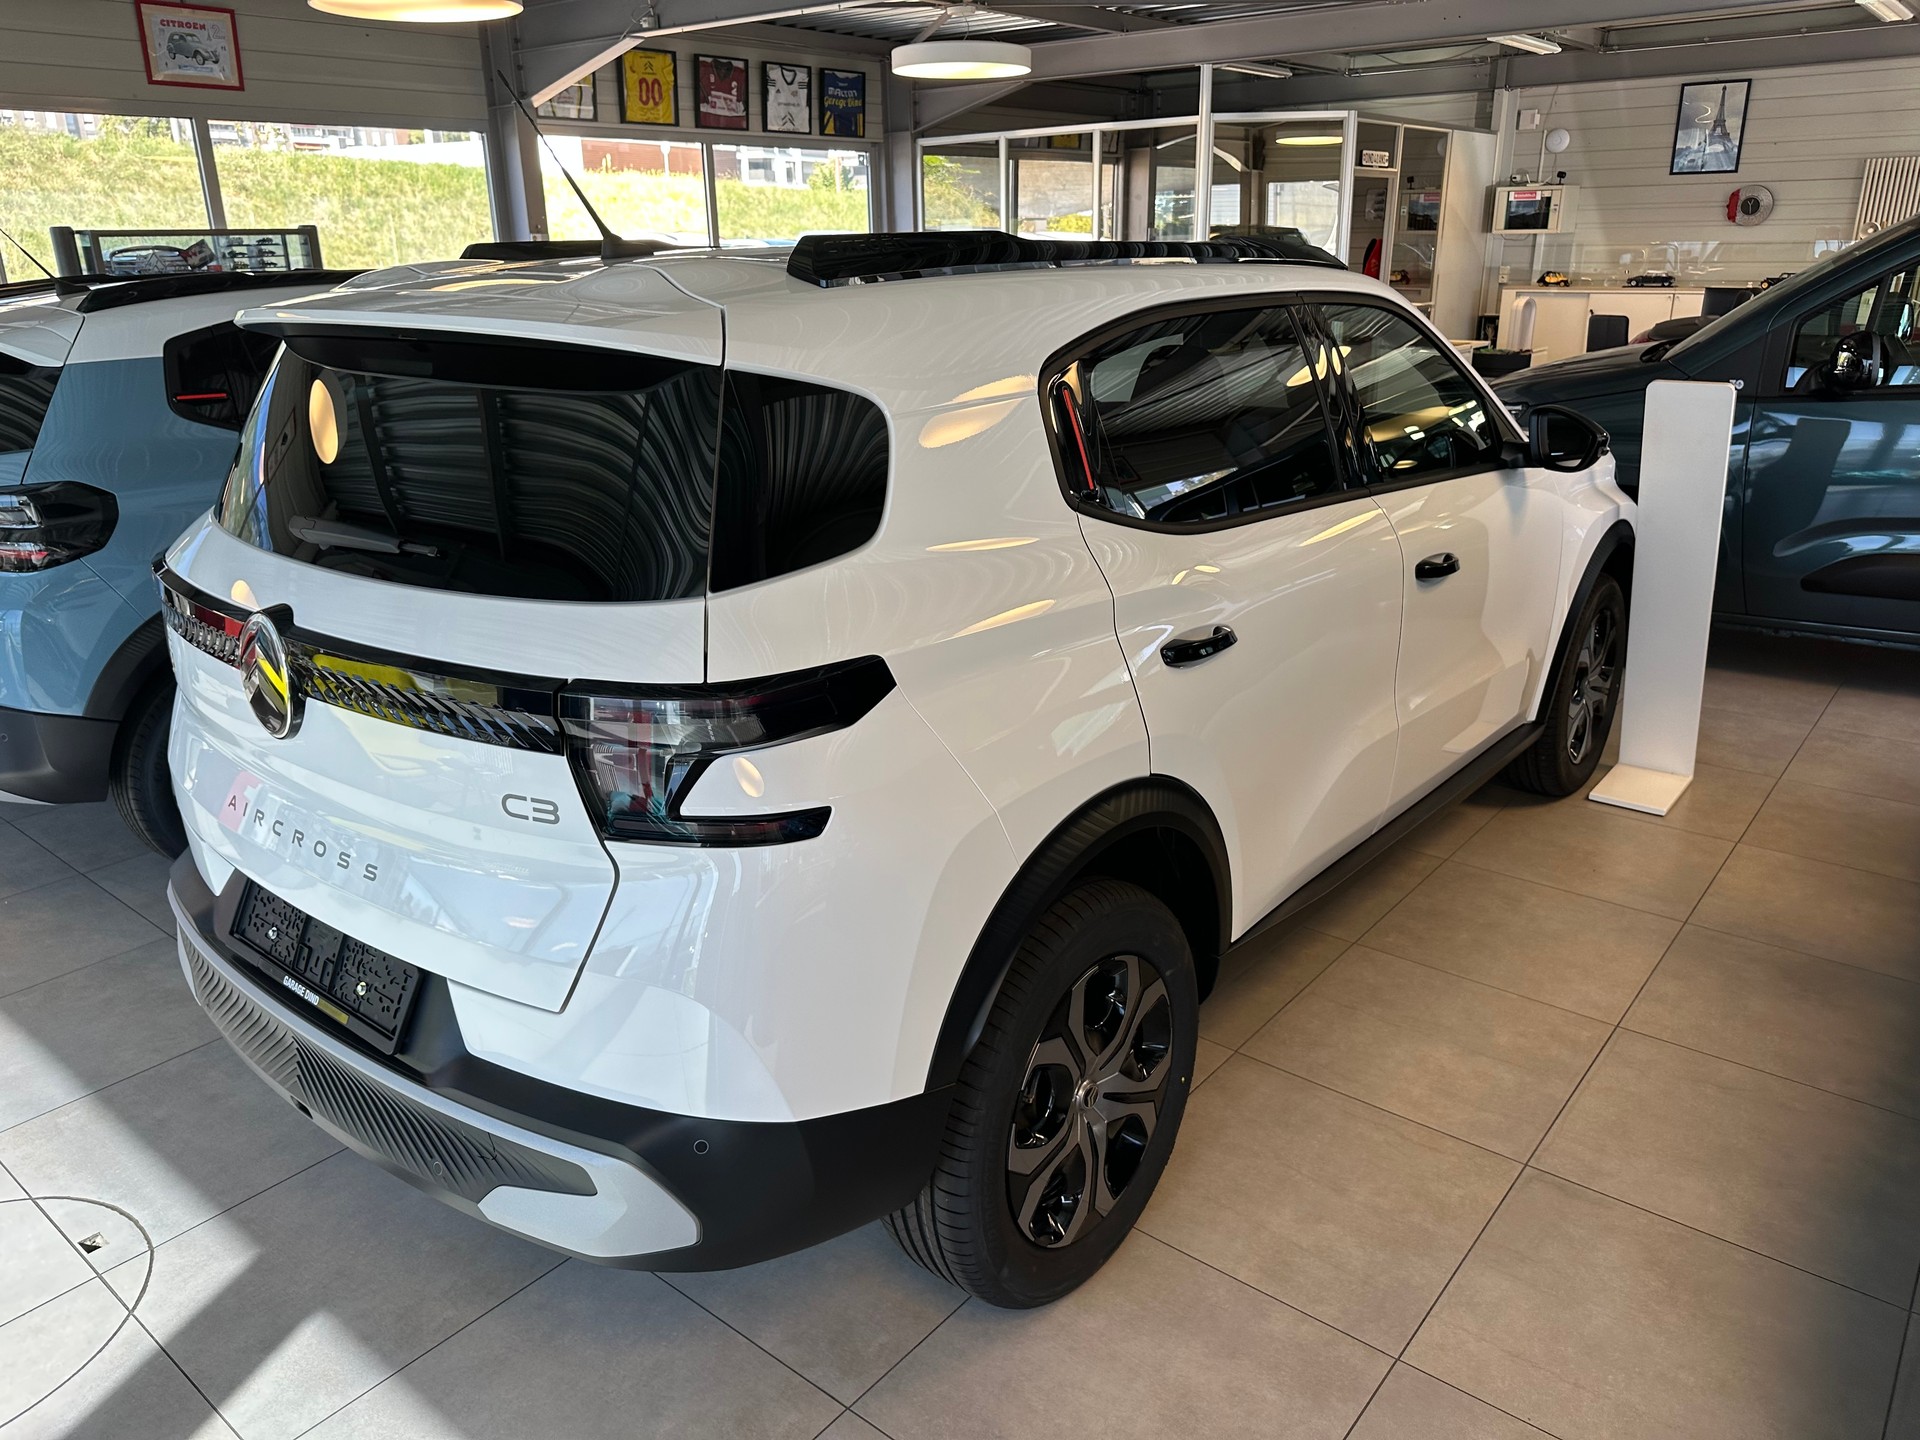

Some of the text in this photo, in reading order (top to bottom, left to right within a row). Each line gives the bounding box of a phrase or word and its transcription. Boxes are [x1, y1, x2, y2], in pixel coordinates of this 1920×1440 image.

[501, 793, 560, 825] C3
[228, 795, 378, 882] AIRCROSS
[283, 975, 320, 1006] GARAGE DINO
